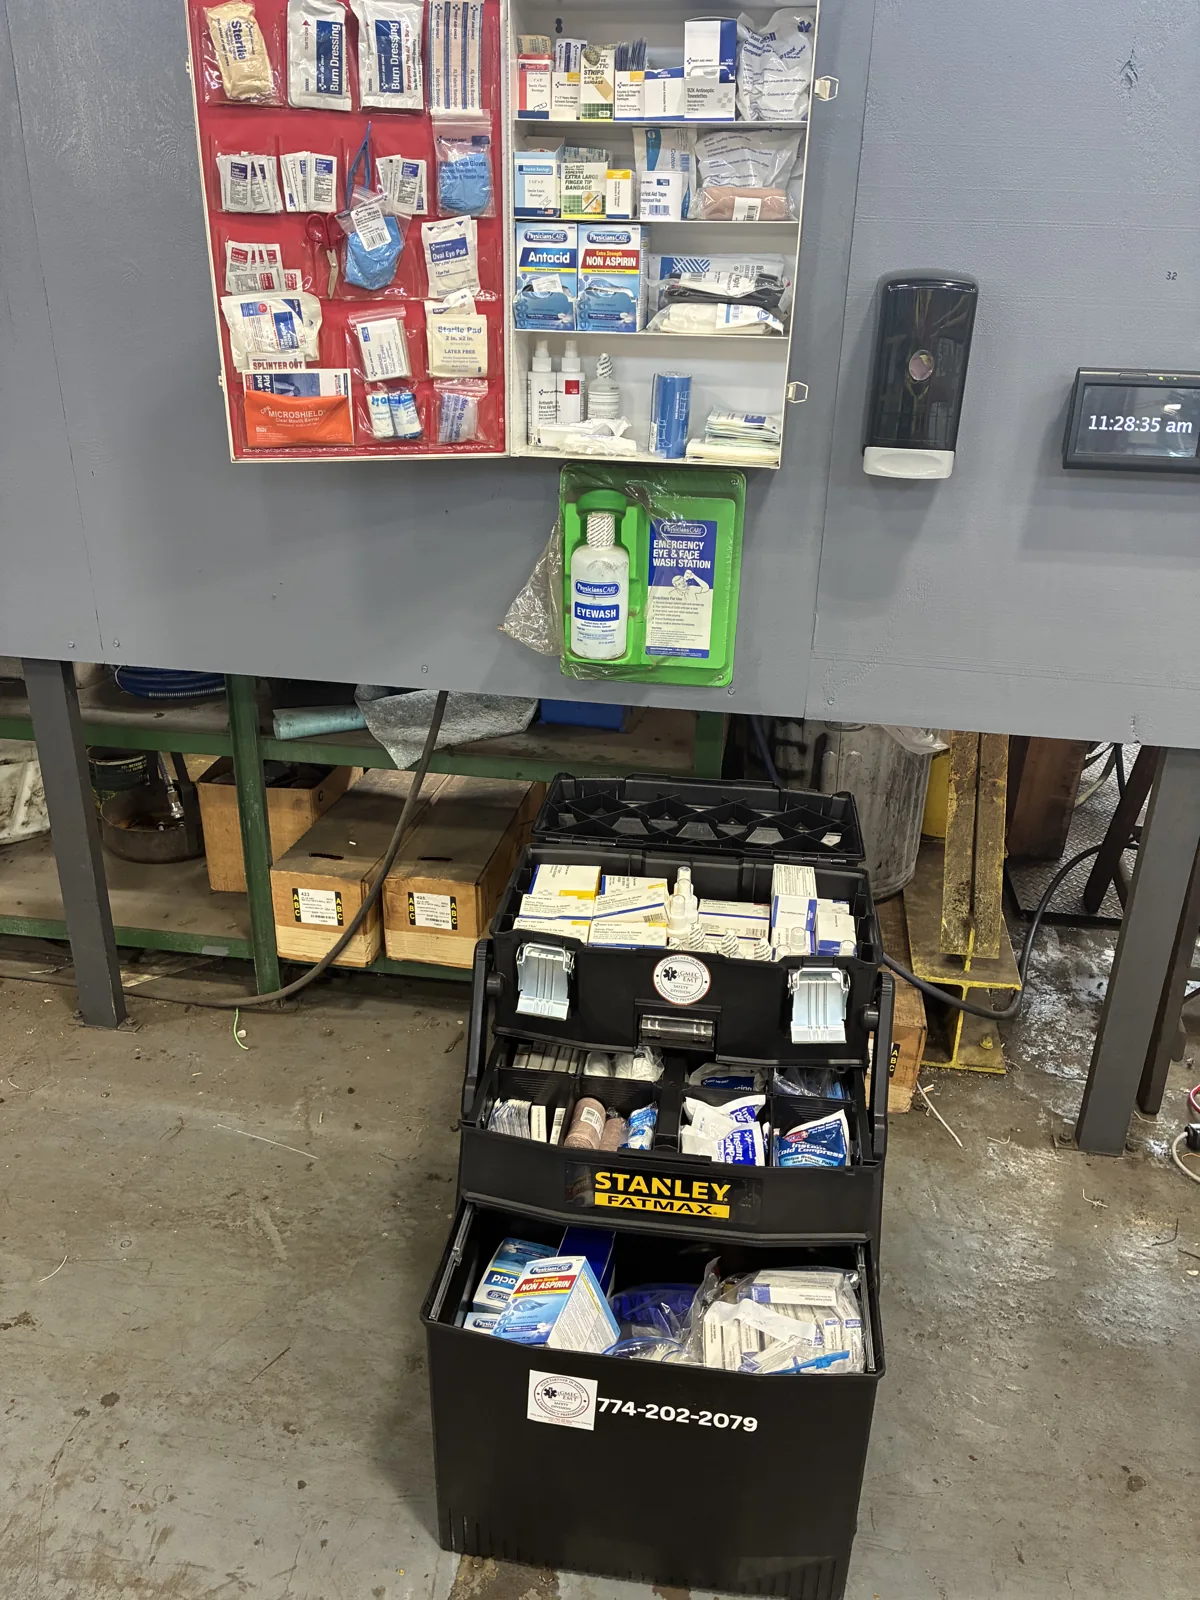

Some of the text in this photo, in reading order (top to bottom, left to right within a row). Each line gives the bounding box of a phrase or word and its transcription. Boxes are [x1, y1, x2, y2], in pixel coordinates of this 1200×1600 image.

[231, 20, 246, 60] Sterile
[330, 24, 341, 92] Burn Dressing
[390, 22, 400, 90] Burn Dressing
[527, 232, 566, 241] PhysiciansCARE
[590, 233, 629, 242] PhysiciansCARE
[432, 252, 444, 260] Oval
[445, 250, 455, 258] Eye
[528, 252, 570, 263] Antacid
[586, 257, 636, 266] NON ASPIRIN
[1165, 271, 1177, 281] 32
[253, 361, 302, 370] SPLINTER OUT
[268, 410, 323, 418] MICROSHIELD
[1088, 414, 1193, 433] 11:28:35 am
[663, 526, 703, 534] PhysiciansCARE
[653, 540, 704, 550] EMERGENCY
[653, 549, 700, 559] EYE & FACE
[653, 558, 711, 569] WASH STATION
[577, 583, 617, 593] PhysiciansCARE
[577, 607, 616, 618] EYEWASH
[890, 1050, 898, 1071] ABC
[733, 1133, 744, 1161] Instant
[777, 1148, 844, 1158] Cold Compress
[595, 1172, 731, 1201] STANLEY
[607, 1195, 713, 1215] FATMAX
[520, 1281, 571, 1291] NON ASPIRIN
[597, 1397, 758, 1432] 774-202-2079
